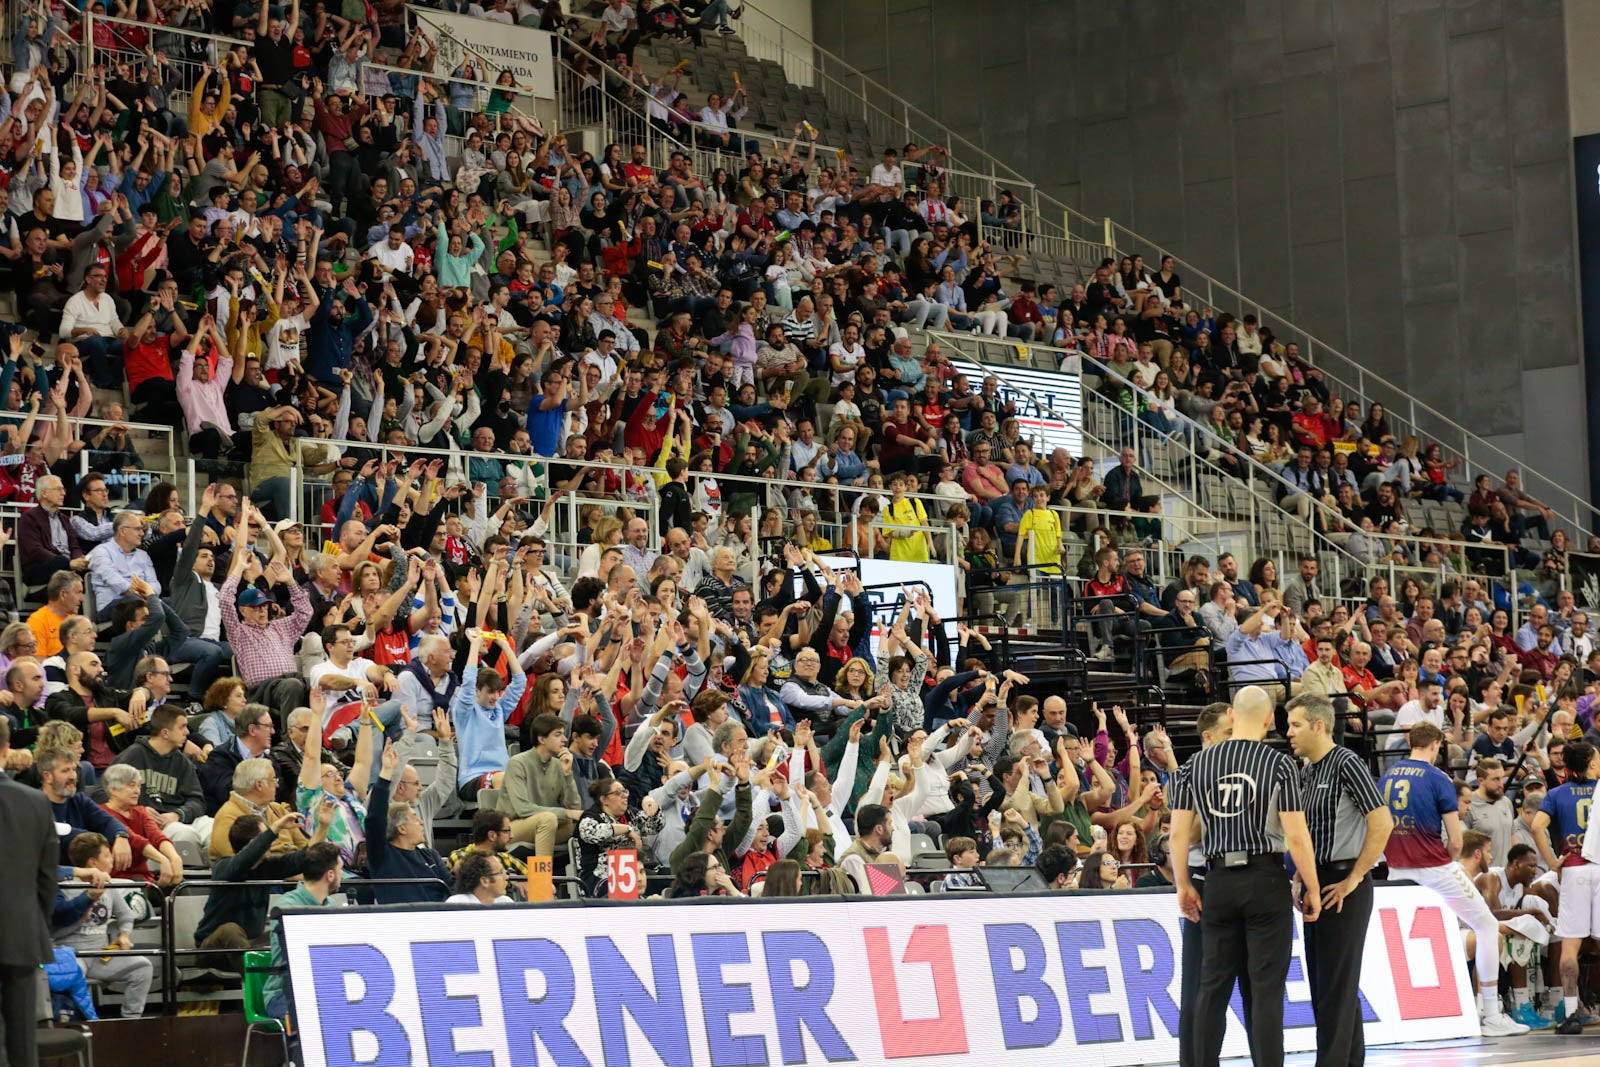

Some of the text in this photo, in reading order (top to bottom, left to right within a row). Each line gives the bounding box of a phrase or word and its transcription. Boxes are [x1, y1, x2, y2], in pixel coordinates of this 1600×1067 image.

[1218, 783, 1243, 807] 77
[1384, 778, 1410, 810] 13
[1570, 786, 1595, 796] TRIC
[608, 854, 637, 894] 55
[308, 930, 859, 1067] BERNER
